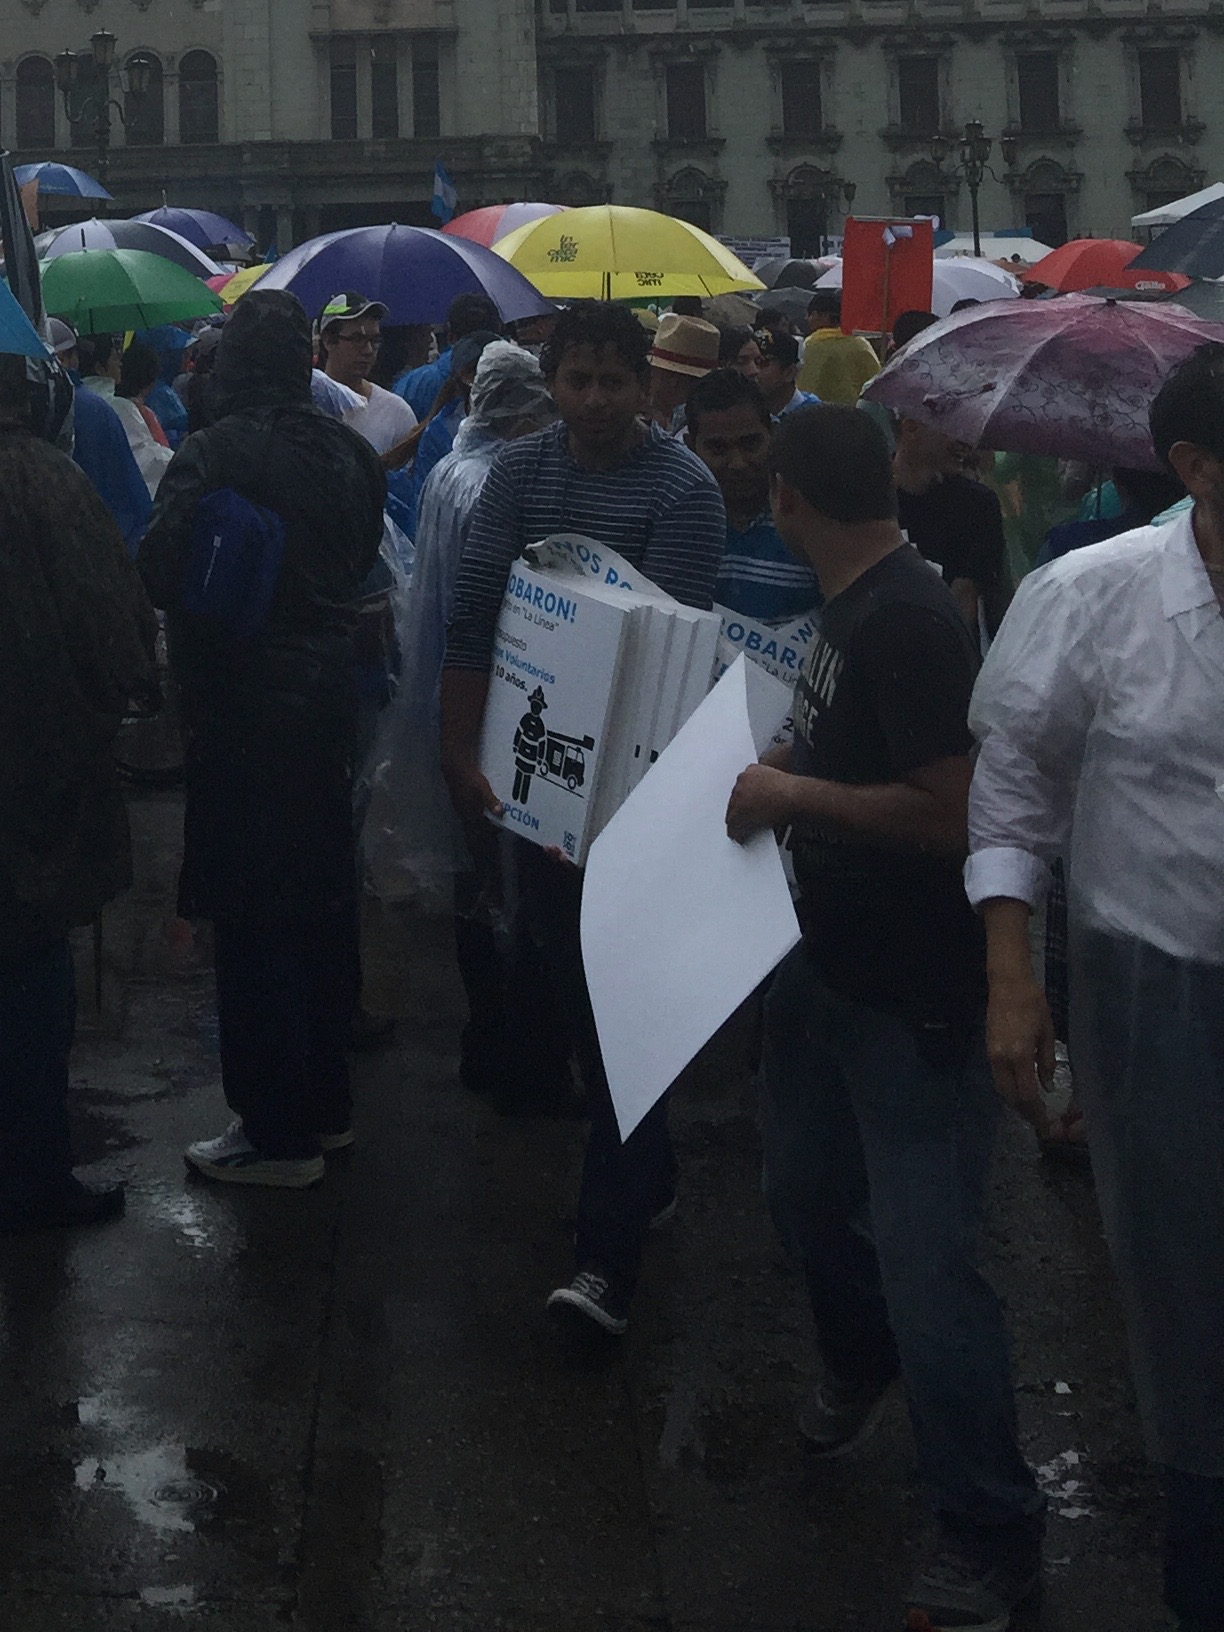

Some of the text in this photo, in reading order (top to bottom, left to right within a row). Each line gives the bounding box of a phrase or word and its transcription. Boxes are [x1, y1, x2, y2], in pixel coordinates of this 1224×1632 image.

[505, 573, 578, 624] OBARON!
[720, 617, 805, 671] OBAR
[503, 803, 540, 830] PCIÓN
